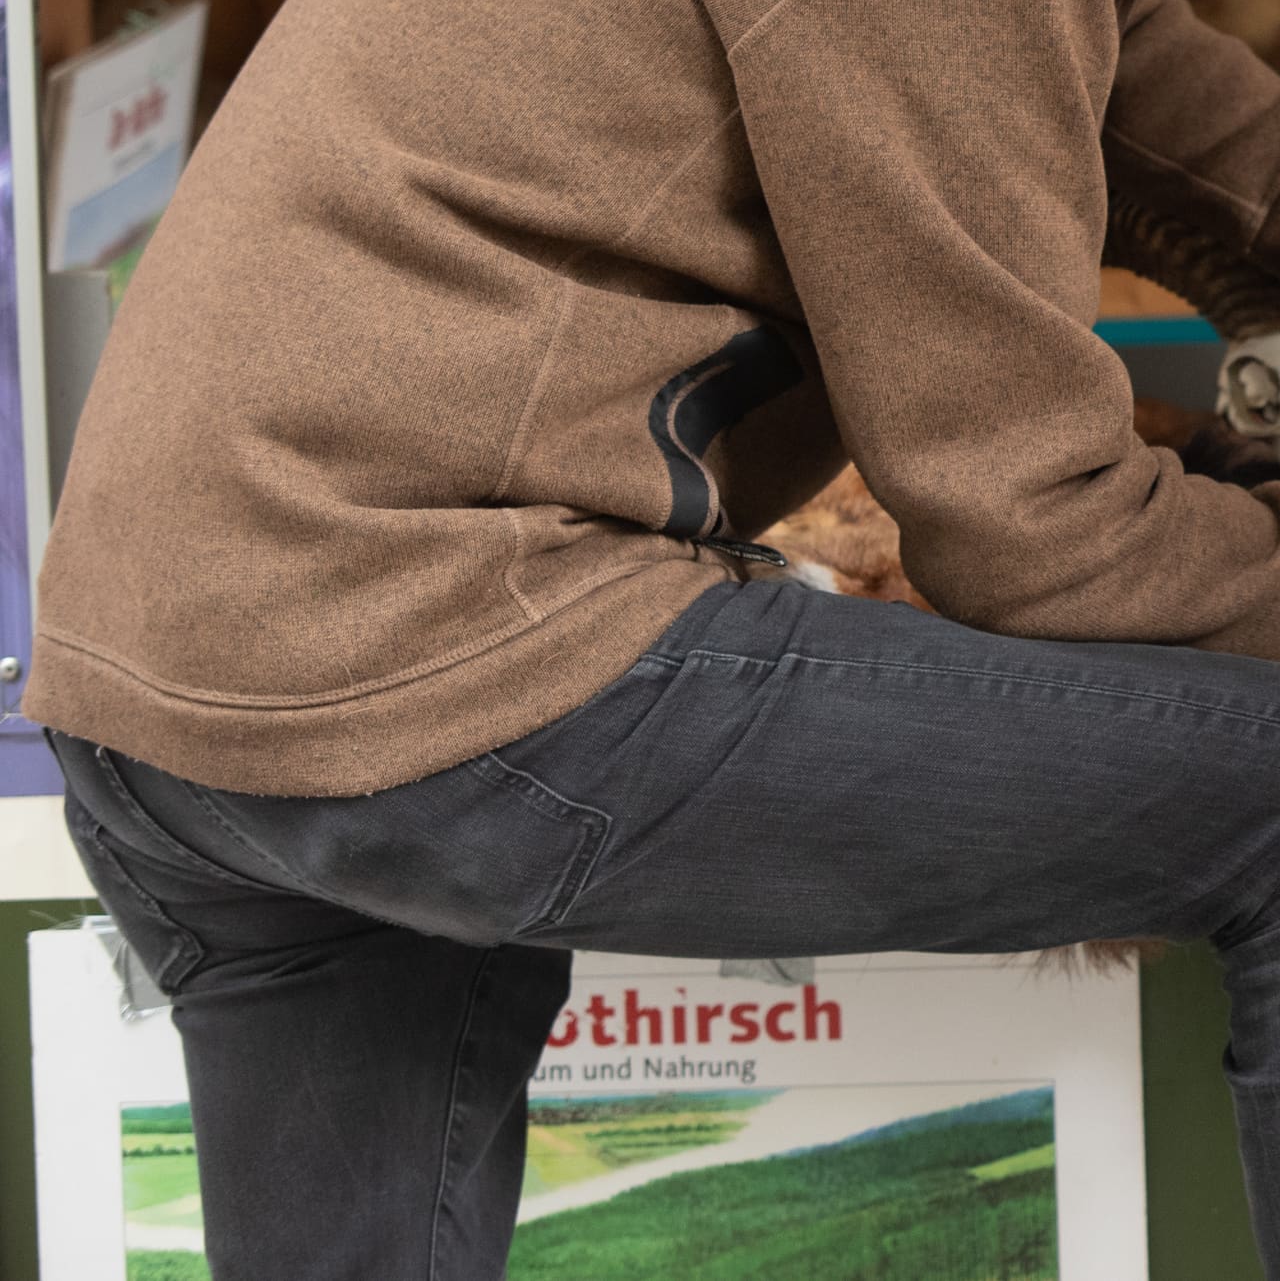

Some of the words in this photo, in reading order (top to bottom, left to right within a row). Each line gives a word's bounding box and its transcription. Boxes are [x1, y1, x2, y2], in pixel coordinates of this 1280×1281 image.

[545, 984, 842, 1048] othirsch
[584, 1056, 632, 1080] und
[644, 1055, 756, 1083] Nahrung
